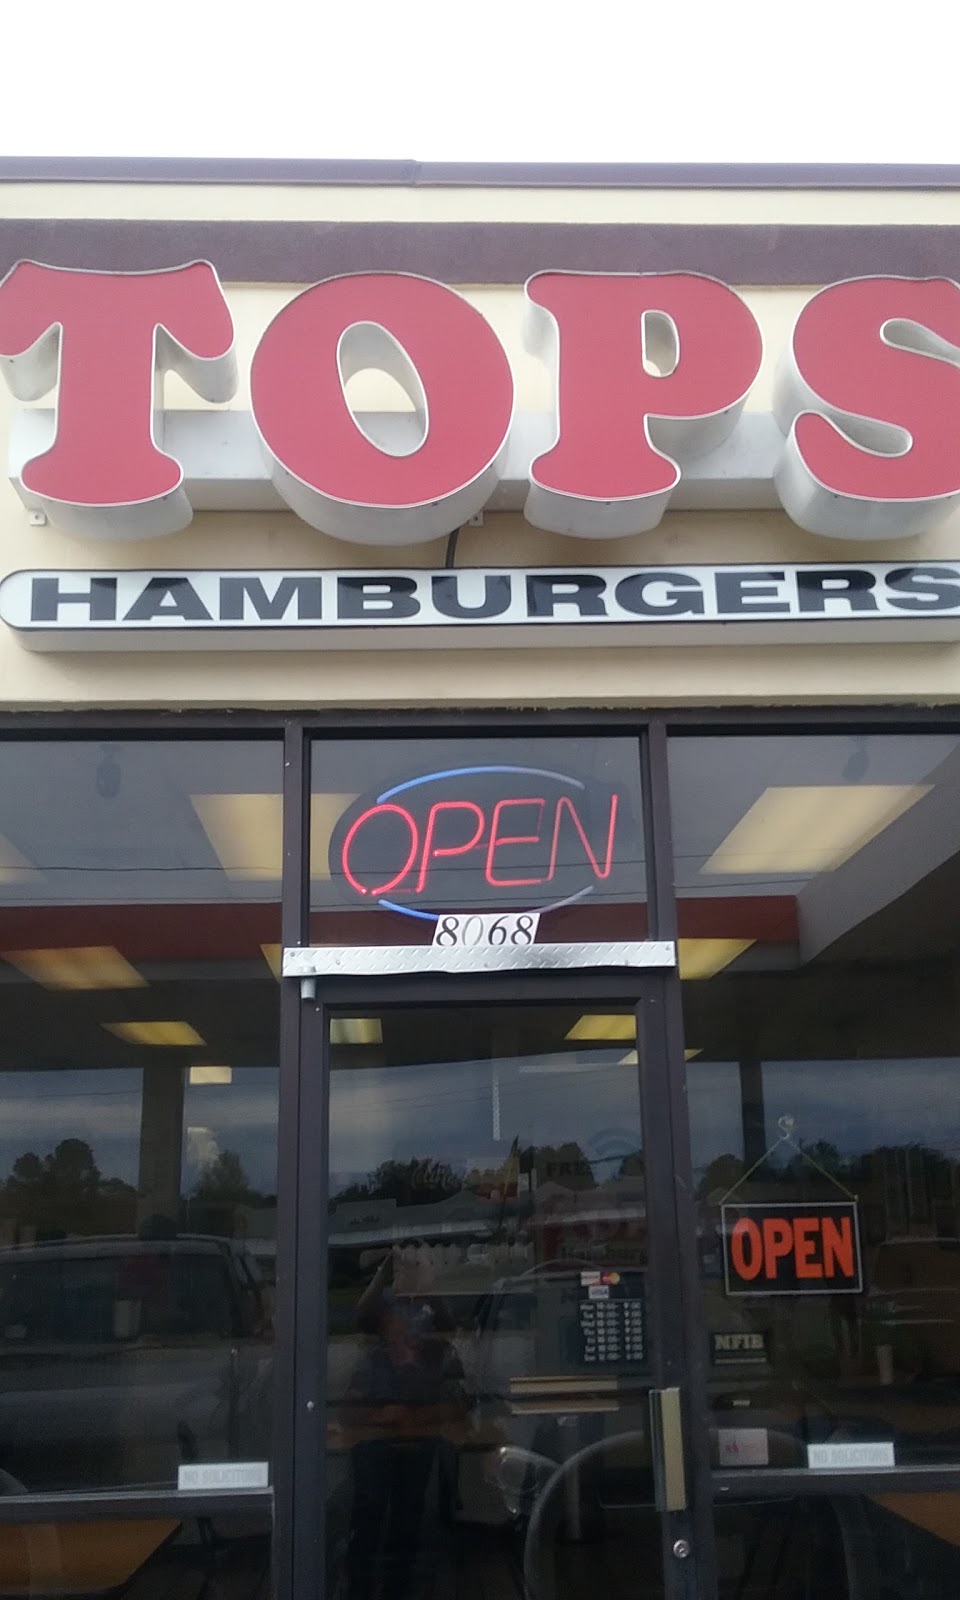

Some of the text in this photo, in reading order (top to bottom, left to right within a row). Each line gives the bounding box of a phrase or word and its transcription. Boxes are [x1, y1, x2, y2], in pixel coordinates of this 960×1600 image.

[0, 258, 960, 509] TOPS
[31, 566, 960, 622] HAMBURGERS
[341, 793, 619, 897] OPEN
[436, 915, 533, 947] 8068
[731, 1216, 855, 1280] OPEN
